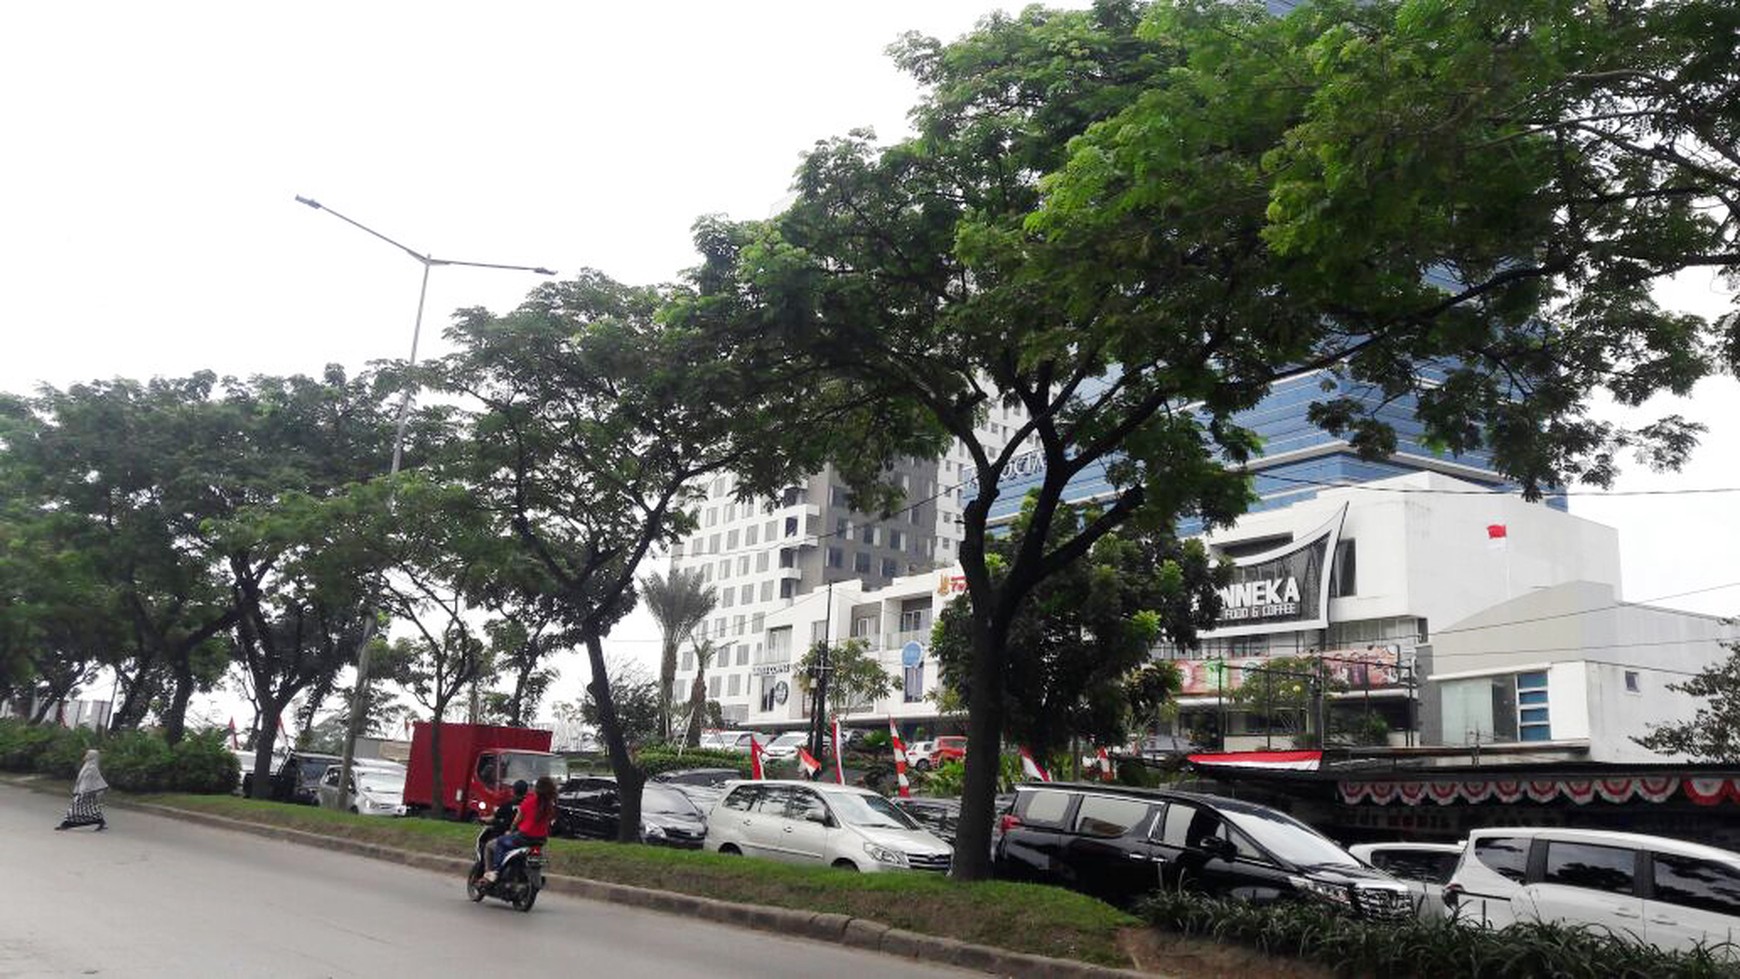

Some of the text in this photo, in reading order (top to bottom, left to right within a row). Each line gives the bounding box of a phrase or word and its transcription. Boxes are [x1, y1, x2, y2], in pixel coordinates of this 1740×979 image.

[1218, 576, 1301, 609] NNEKA
[1224, 606, 1249, 620] FOOD
[1262, 602, 1296, 616] COFFEE
